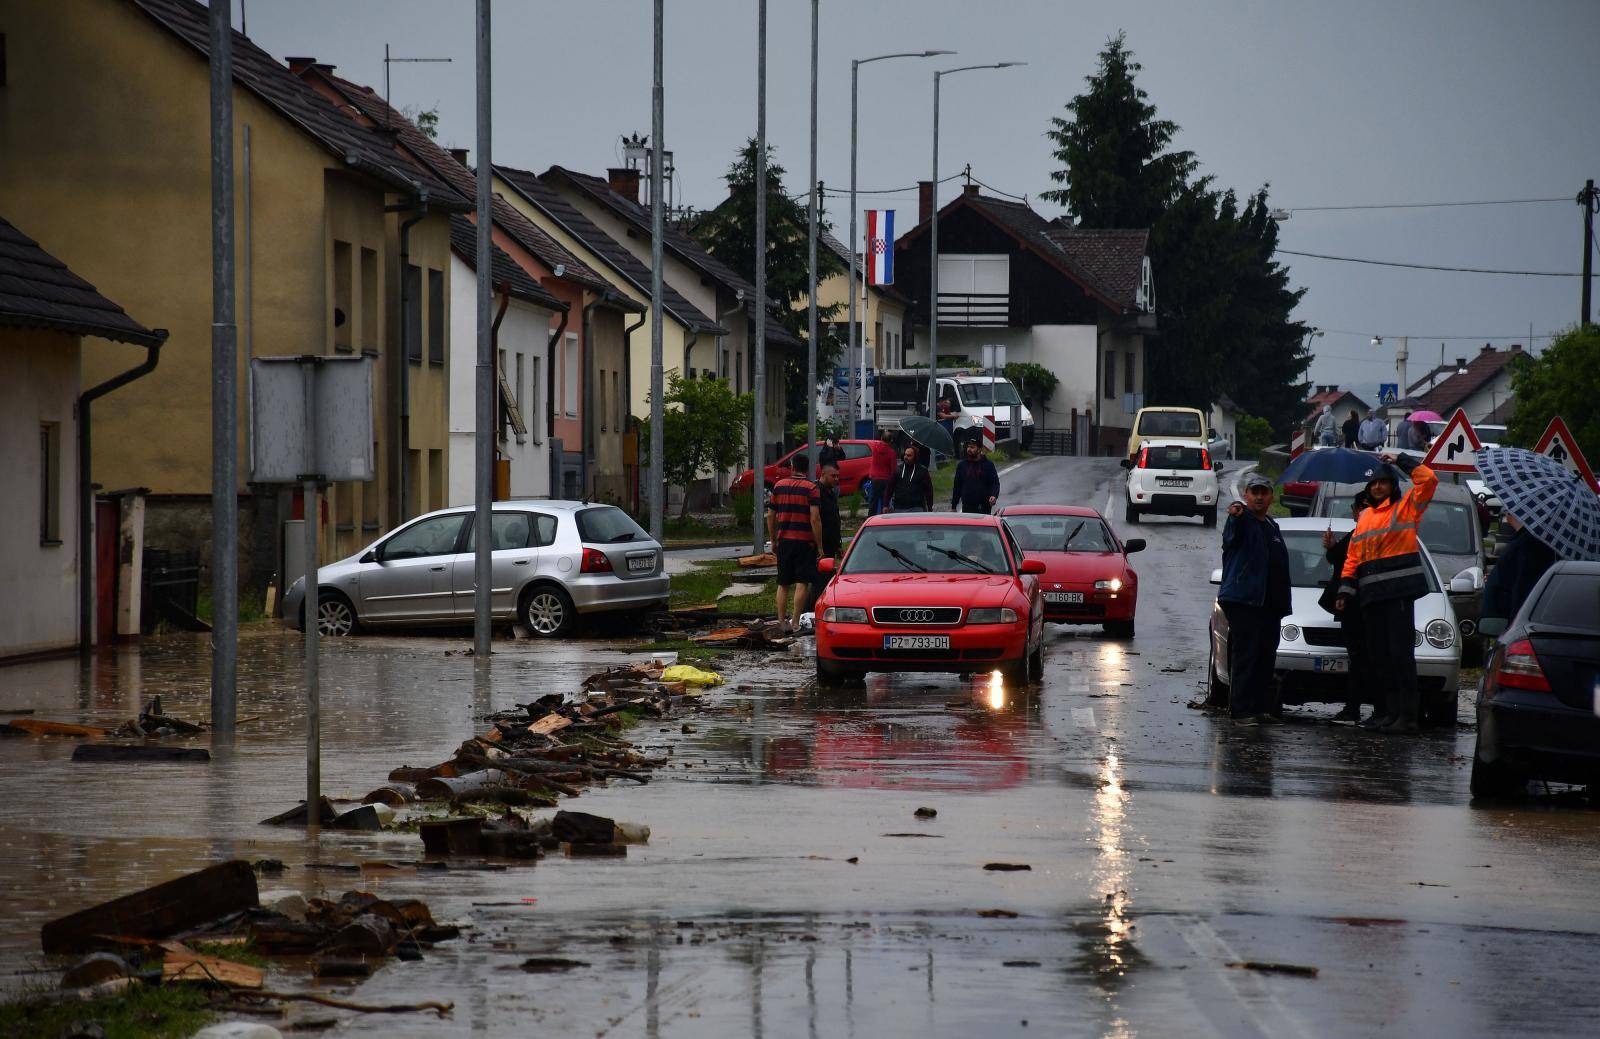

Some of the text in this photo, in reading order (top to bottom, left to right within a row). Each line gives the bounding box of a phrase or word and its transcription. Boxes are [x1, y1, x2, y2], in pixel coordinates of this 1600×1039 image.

[891, 637, 948, 649] PZ 793-DH
[1322, 659, 1337, 671] PZ
